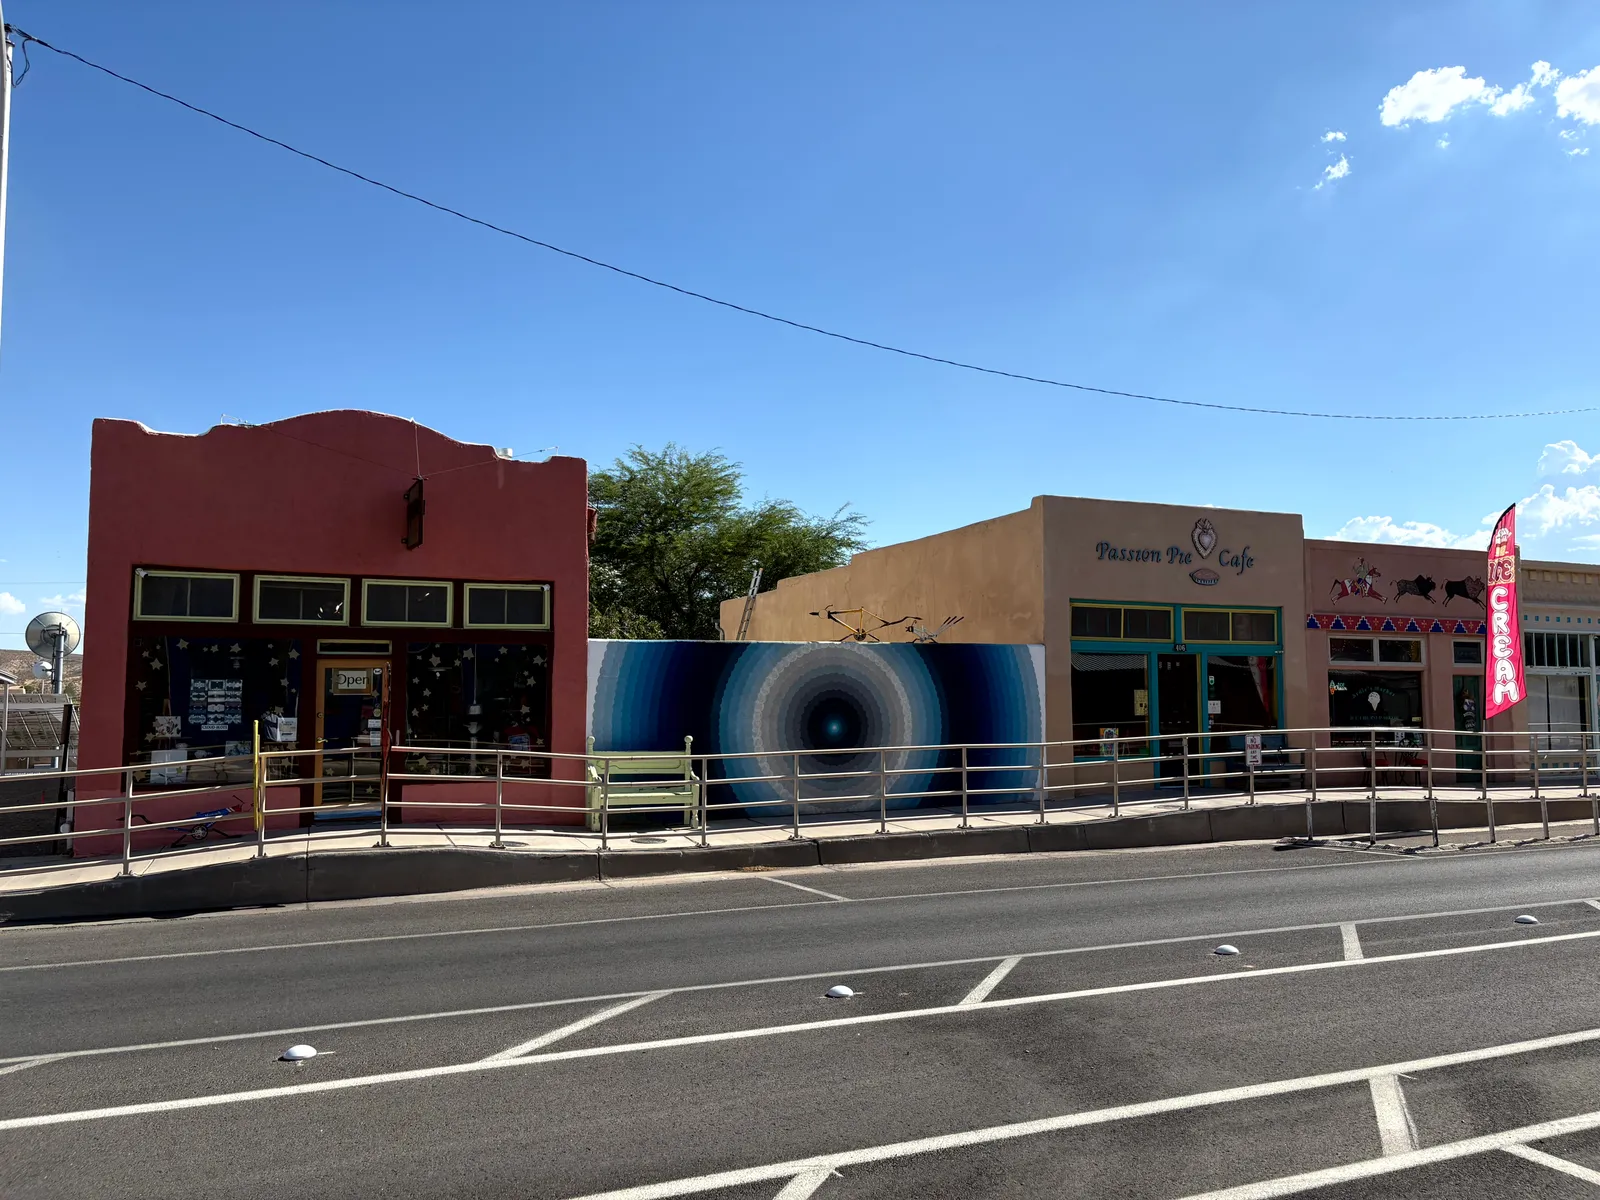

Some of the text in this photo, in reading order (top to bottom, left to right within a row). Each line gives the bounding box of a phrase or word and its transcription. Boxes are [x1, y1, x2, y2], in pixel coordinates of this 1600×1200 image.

[1096, 541, 1254, 576] Passion Pie Cafe
[1488, 558, 1514, 584] ICE
[1491, 586, 1520, 706] CREAM
[335, 673, 369, 688] Open
